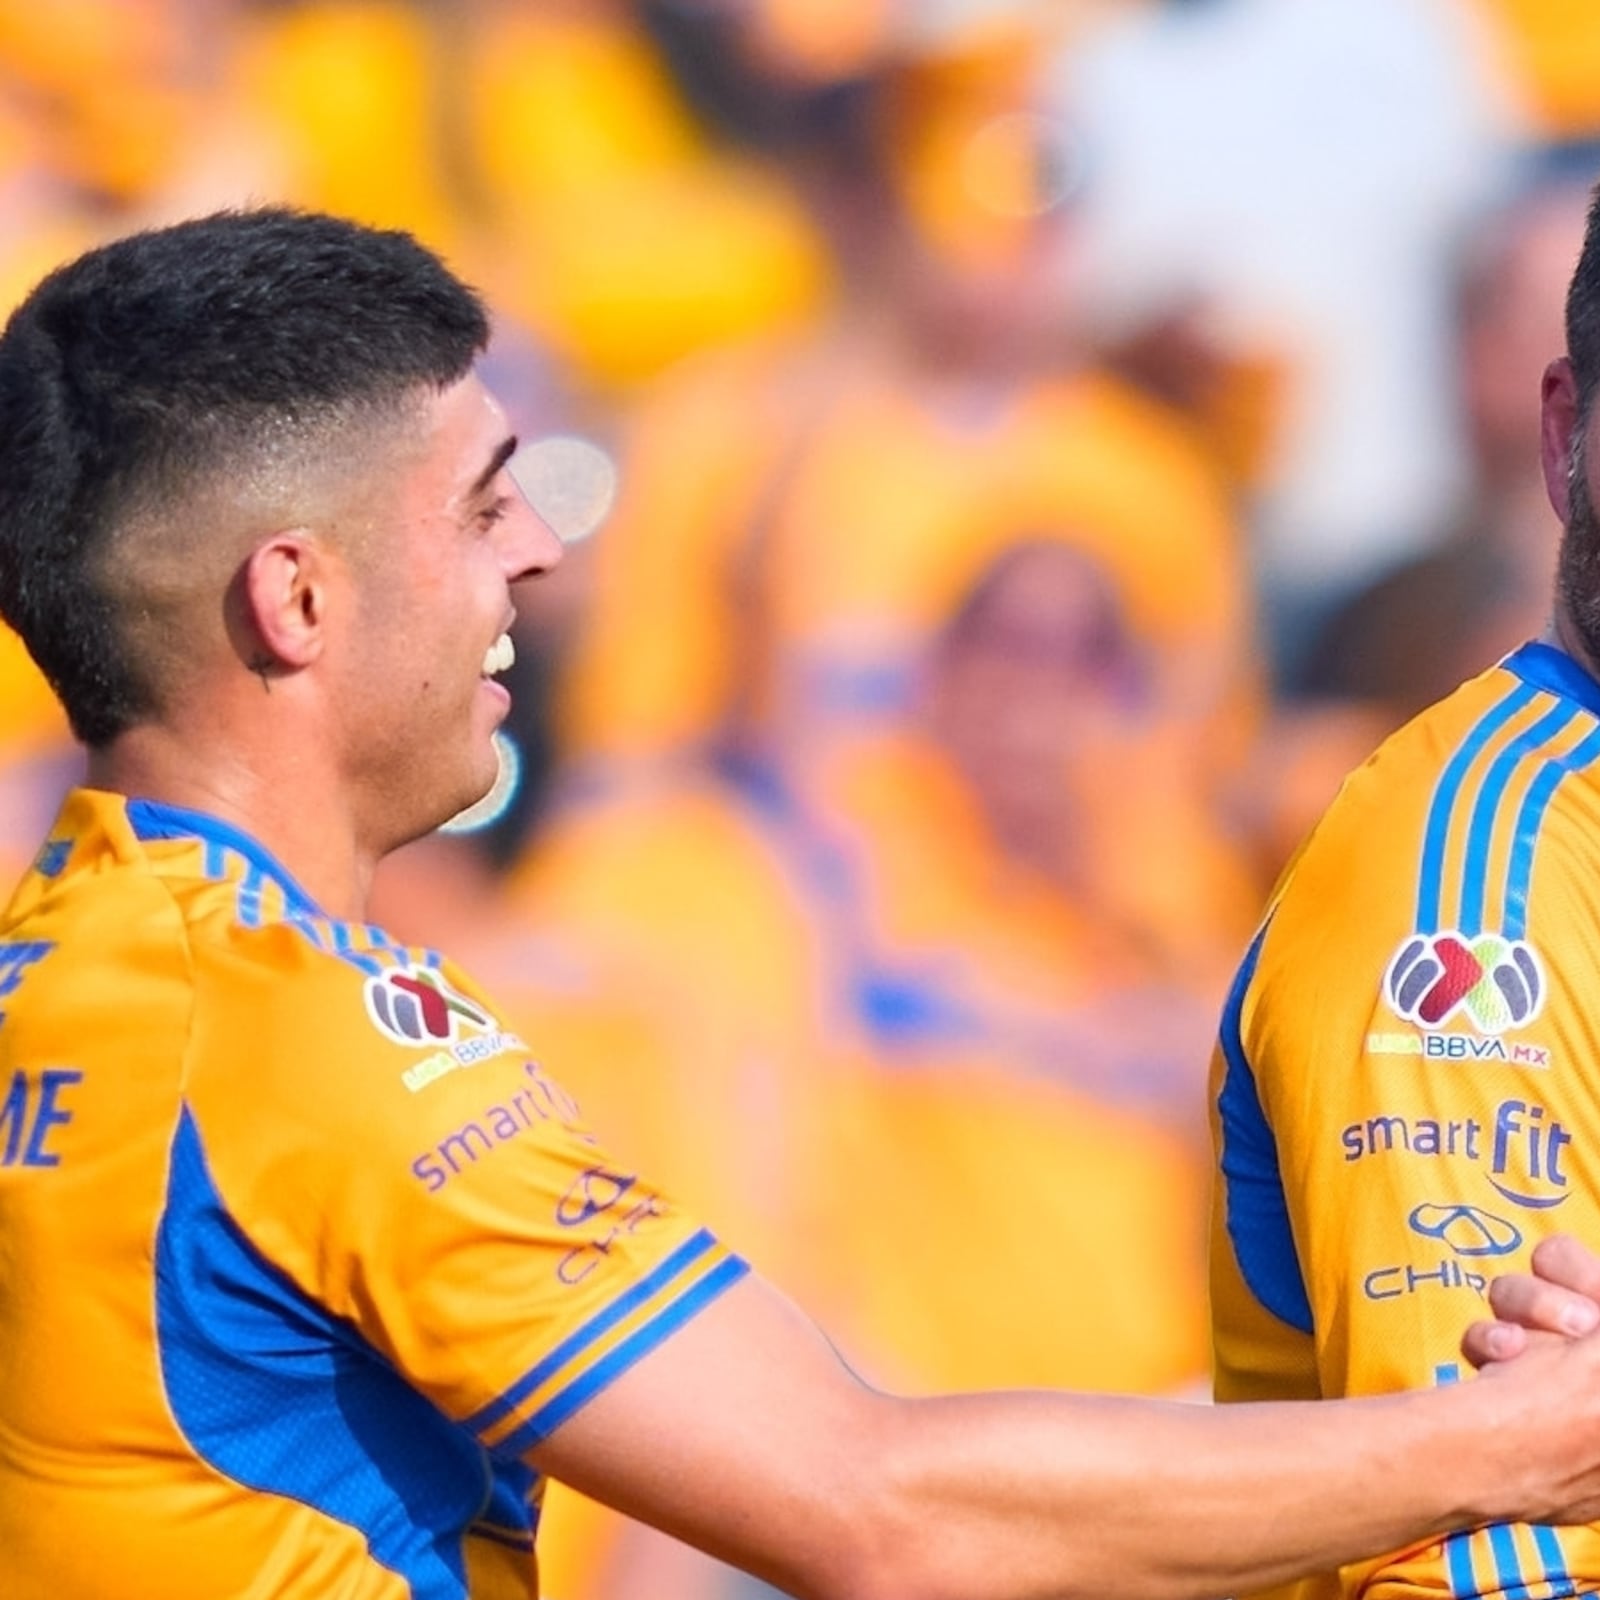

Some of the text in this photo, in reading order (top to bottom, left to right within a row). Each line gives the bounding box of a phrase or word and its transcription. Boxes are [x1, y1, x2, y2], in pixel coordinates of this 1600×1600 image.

[1427, 1036, 1505, 1058] BBVA
[1513, 1045, 1547, 1065] MX
[1342, 1099, 1572, 1186] smart fit
